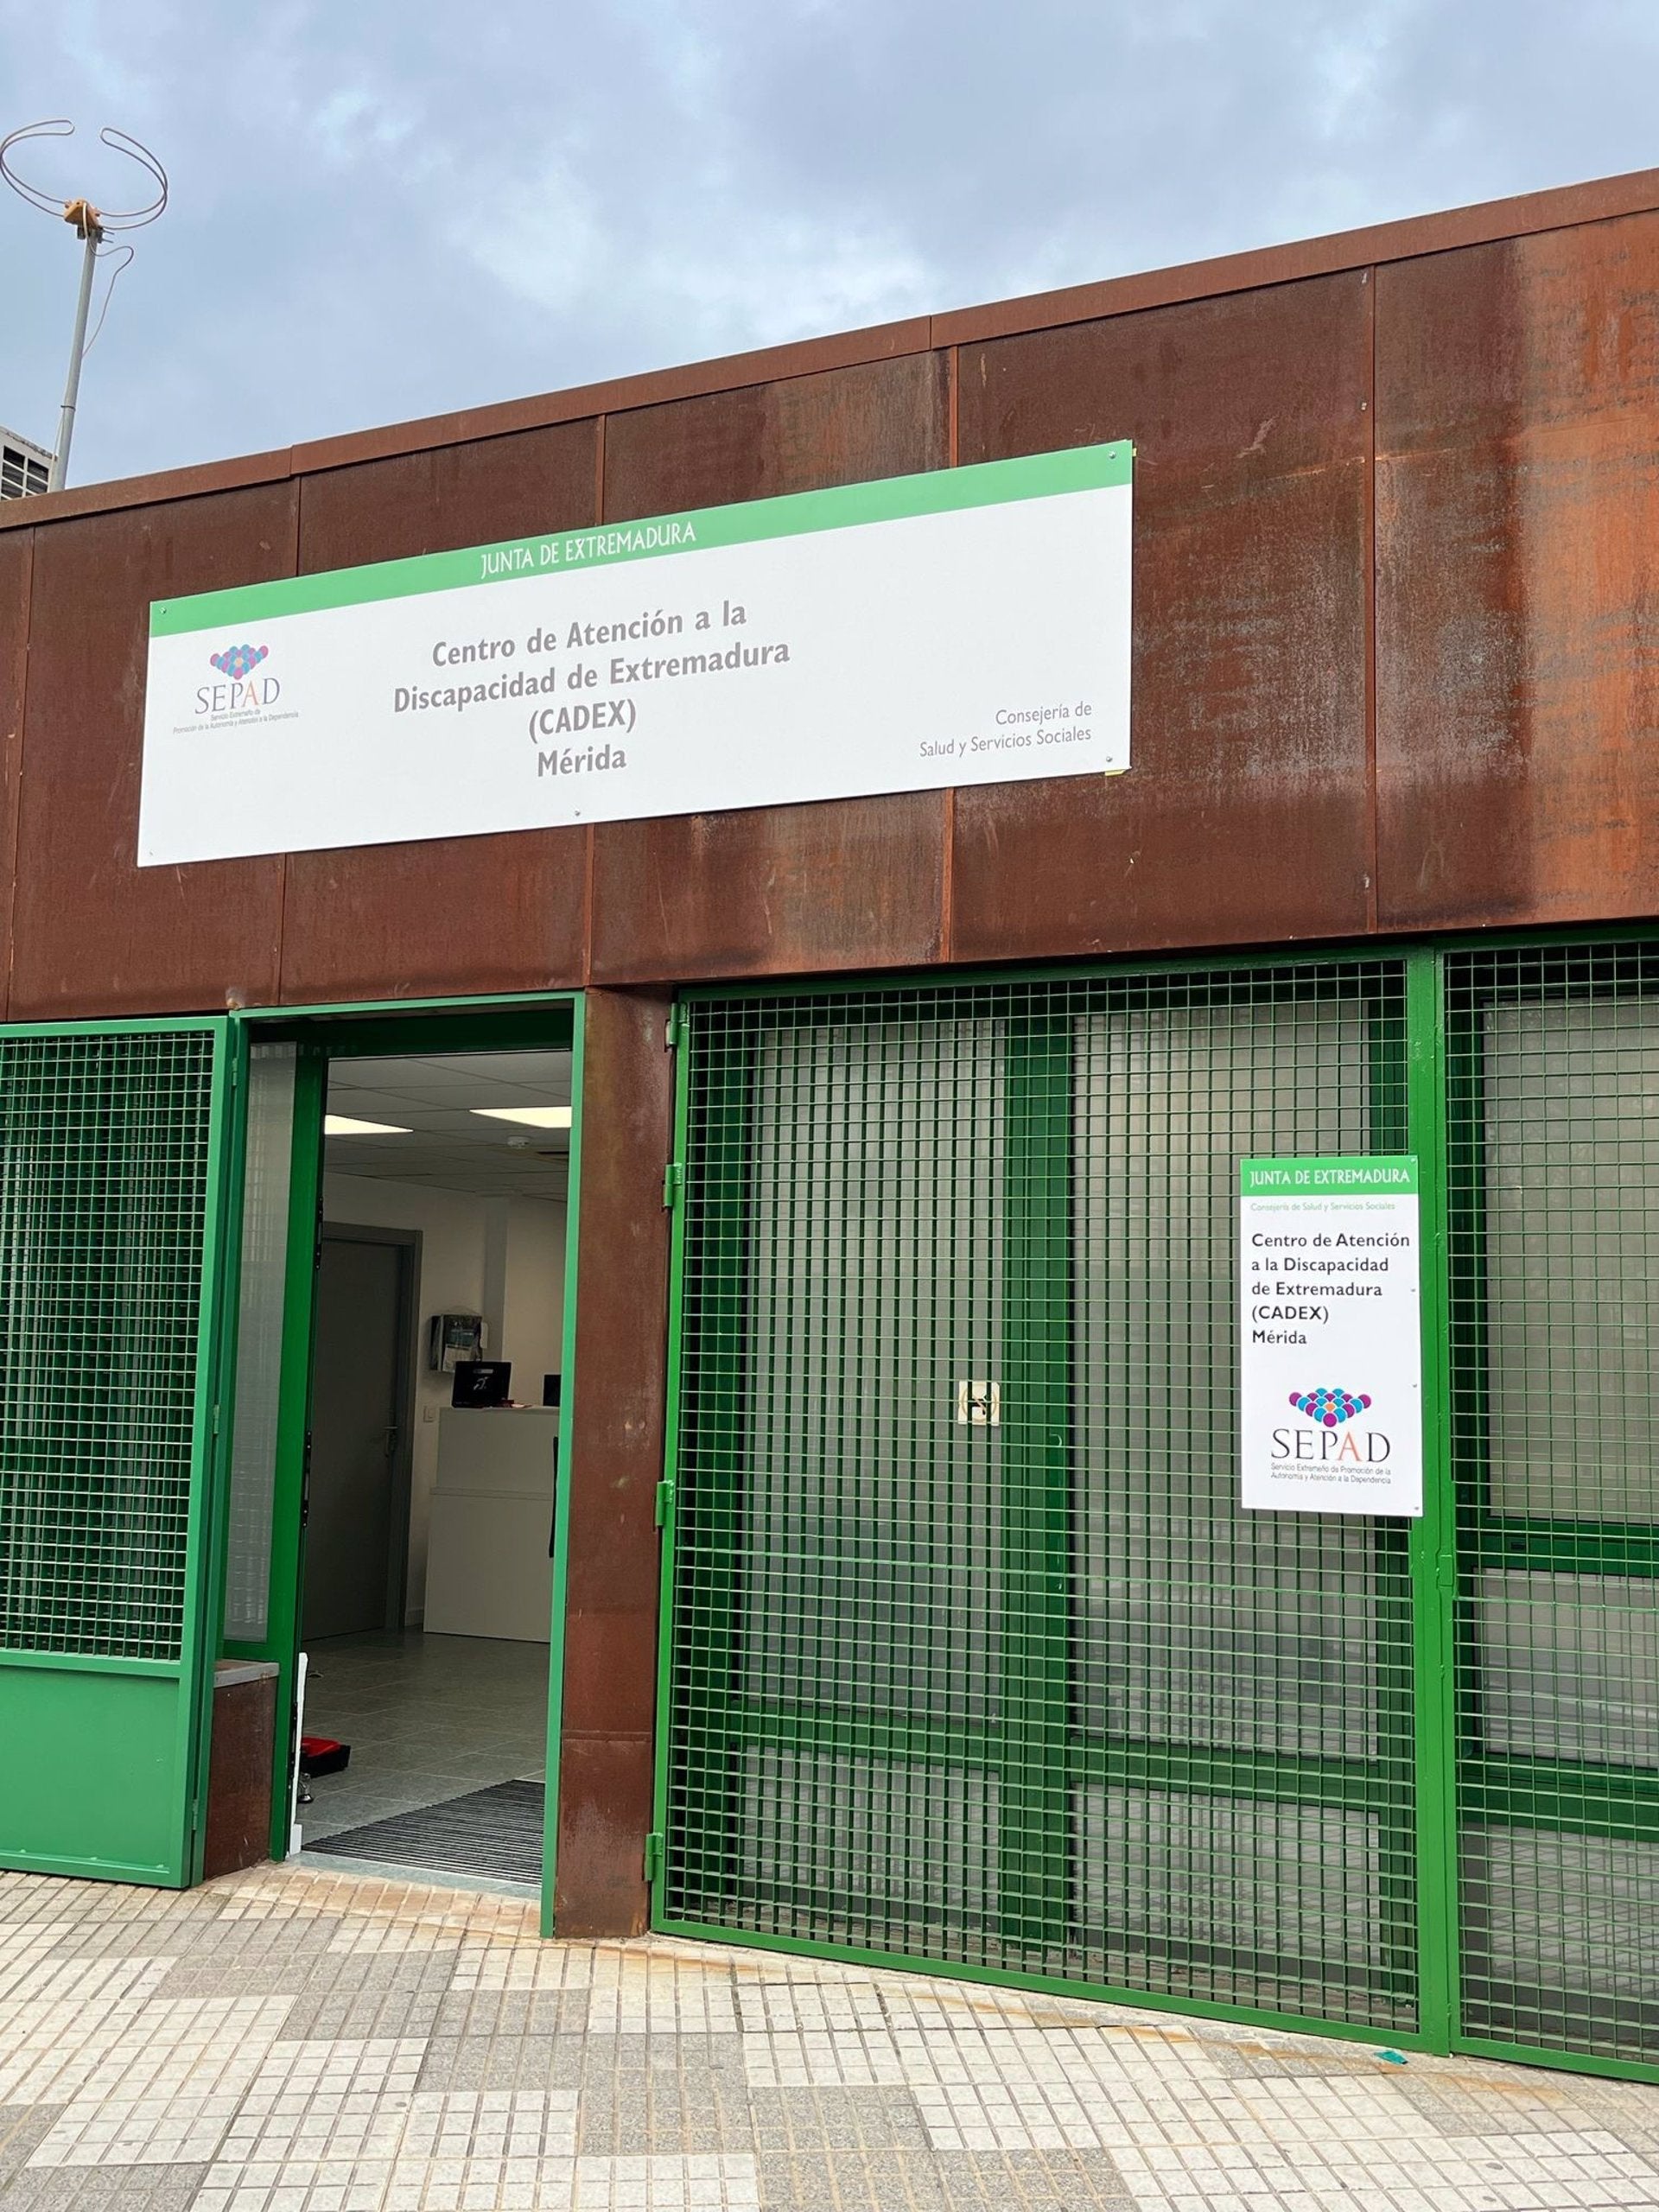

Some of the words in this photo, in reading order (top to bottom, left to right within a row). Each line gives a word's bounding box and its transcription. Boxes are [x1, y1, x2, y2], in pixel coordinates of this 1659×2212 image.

[481, 548, 534, 579] JUNTA
[541, 543, 560, 565] DE
[566, 522, 696, 562] EXTREMADURA
[433, 638, 515, 667] Centro
[527, 627, 556, 653] de
[567, 609, 683, 648] Atención
[695, 612, 710, 631] a
[723, 600, 747, 627] la
[394, 667, 555, 713] Discapacidad
[567, 663, 598, 691] de
[610, 641, 791, 684] Extremadura
[194, 677, 280, 715] SEPAD
[529, 698, 637, 744] (CADEX)
[995, 703, 1070, 726] Consejería
[1075, 701, 1092, 717] de
[919, 739, 954, 757] Salud
[959, 742, 967, 758] y
[971, 734, 1032, 752] Servicios
[1037, 726, 1091, 745] Sociales
[537, 743, 627, 778] Mérida
[1249, 1170, 1291, 1188] JUNTA
[1296, 1170, 1310, 1184] DE
[1314, 1168, 1410, 1184] EXTREMADURA
[1250, 1202, 1289, 1212] Consejería
[1365, 1201, 1395, 1210] Sociales
[1252, 1233, 1306, 1247] Centro
[1313, 1233, 1332, 1247] de
[1336, 1232, 1410, 1246] Atención
[1251, 1261, 1260, 1271] a
[1265, 1257, 1278, 1271] la
[1284, 1257, 1389, 1275] Discapacidad
[1251, 1282, 1270, 1295] de
[1276, 1282, 1382, 1296] Extremadura
[1252, 1305, 1329, 1324] (CADEX)
[1253, 1331, 1306, 1344] Mérida
[1271, 1429, 1390, 1462] SEPAD
[1340, 1465, 1374, 1474] Promoción
[1351, 1475, 1391, 1484] Dependencia
